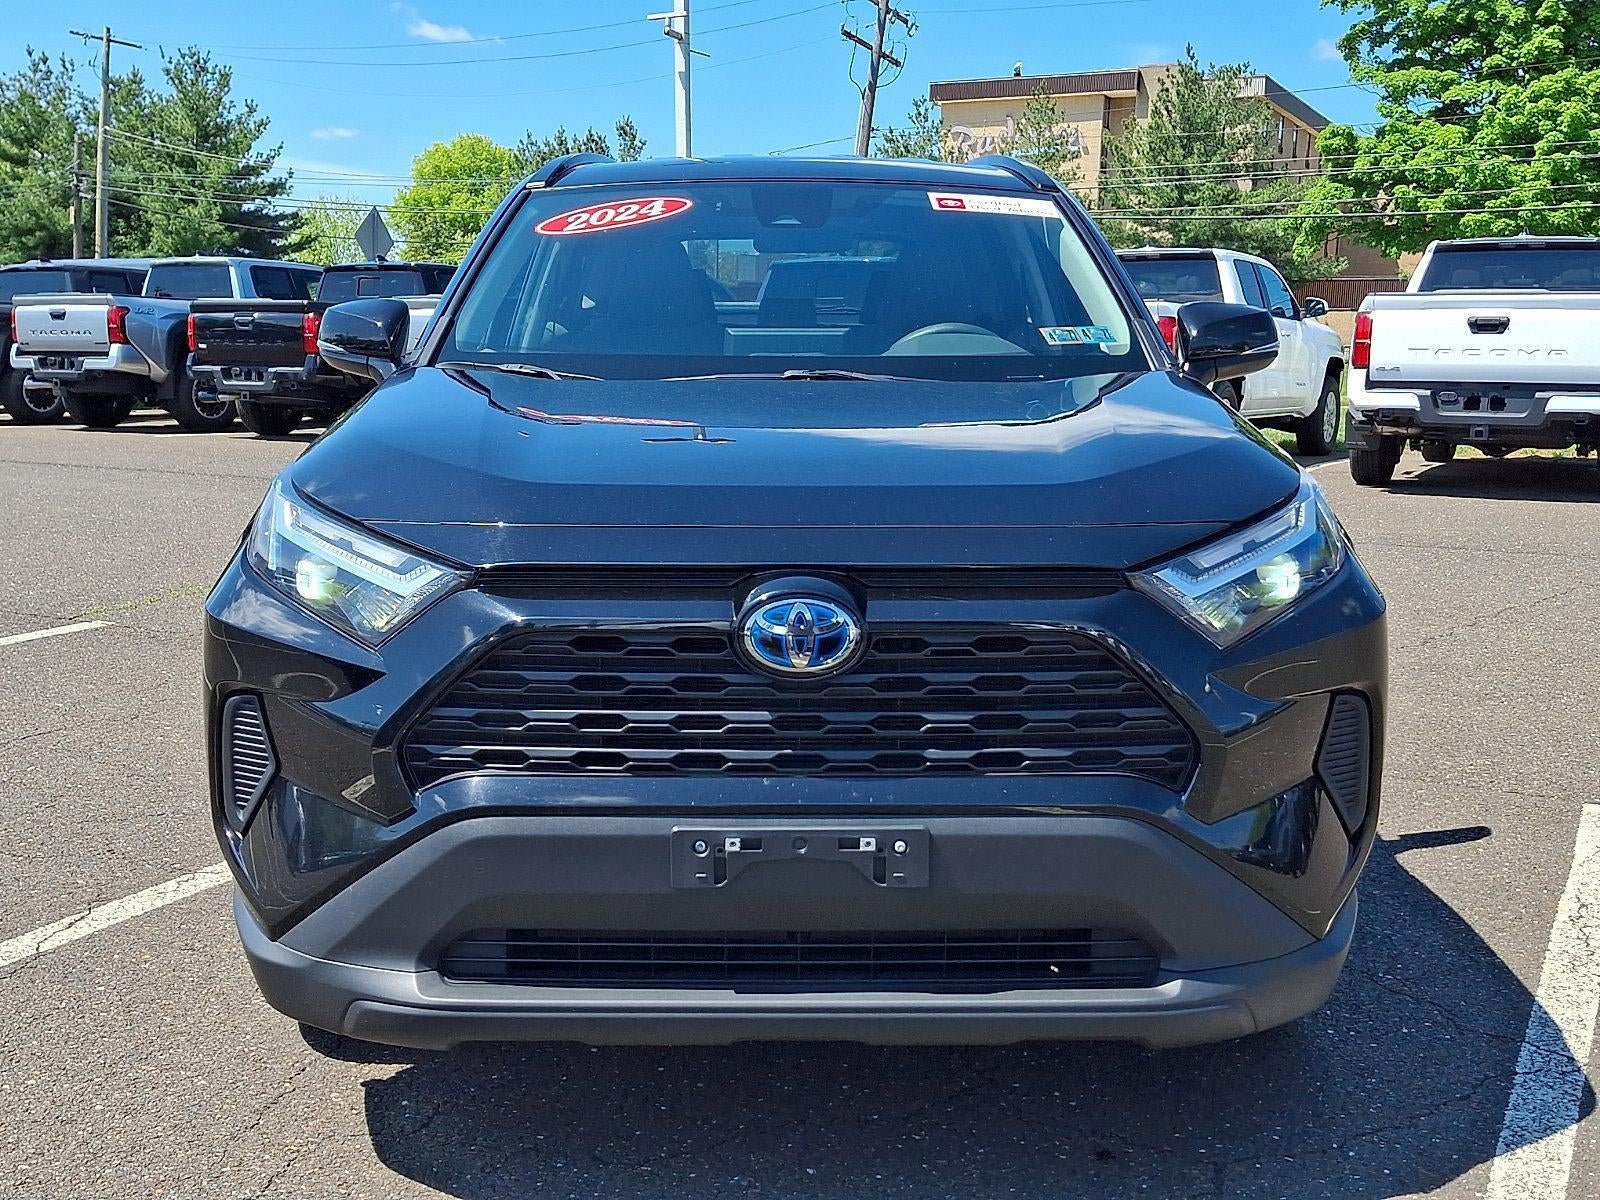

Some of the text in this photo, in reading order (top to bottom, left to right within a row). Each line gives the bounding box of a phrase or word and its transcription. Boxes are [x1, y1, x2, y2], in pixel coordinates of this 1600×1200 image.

[948, 114, 1090, 164] Radon
[562, 199, 667, 232] 2024
[29, 329, 92, 337] TACOMA
[1407, 347, 1569, 361] TACOMA
